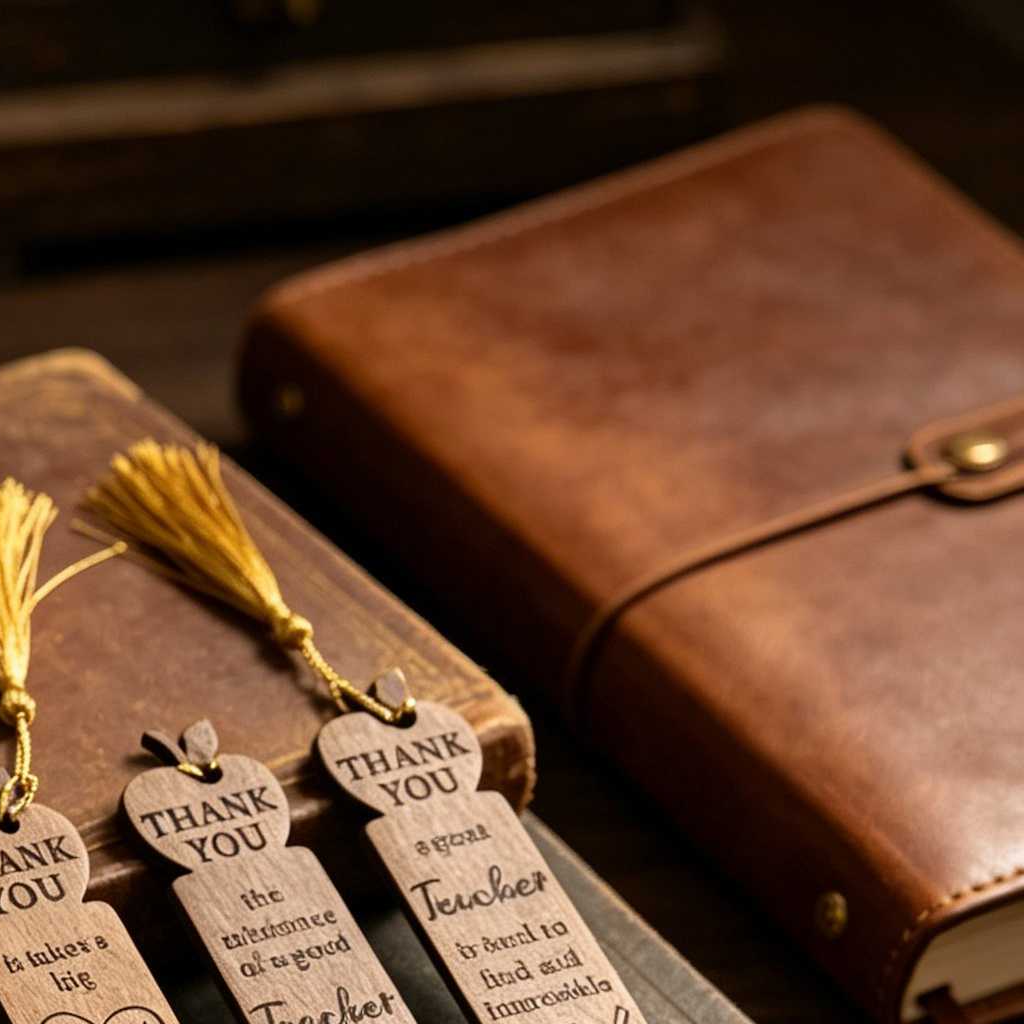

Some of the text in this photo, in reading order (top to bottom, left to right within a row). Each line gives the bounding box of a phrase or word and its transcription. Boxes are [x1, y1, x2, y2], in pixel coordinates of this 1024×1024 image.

[336, 731, 472, 783] THANK
[378, 767, 459, 808] YOU
[140, 786, 279, 840] THANK
[184, 824, 268, 864] YOU
